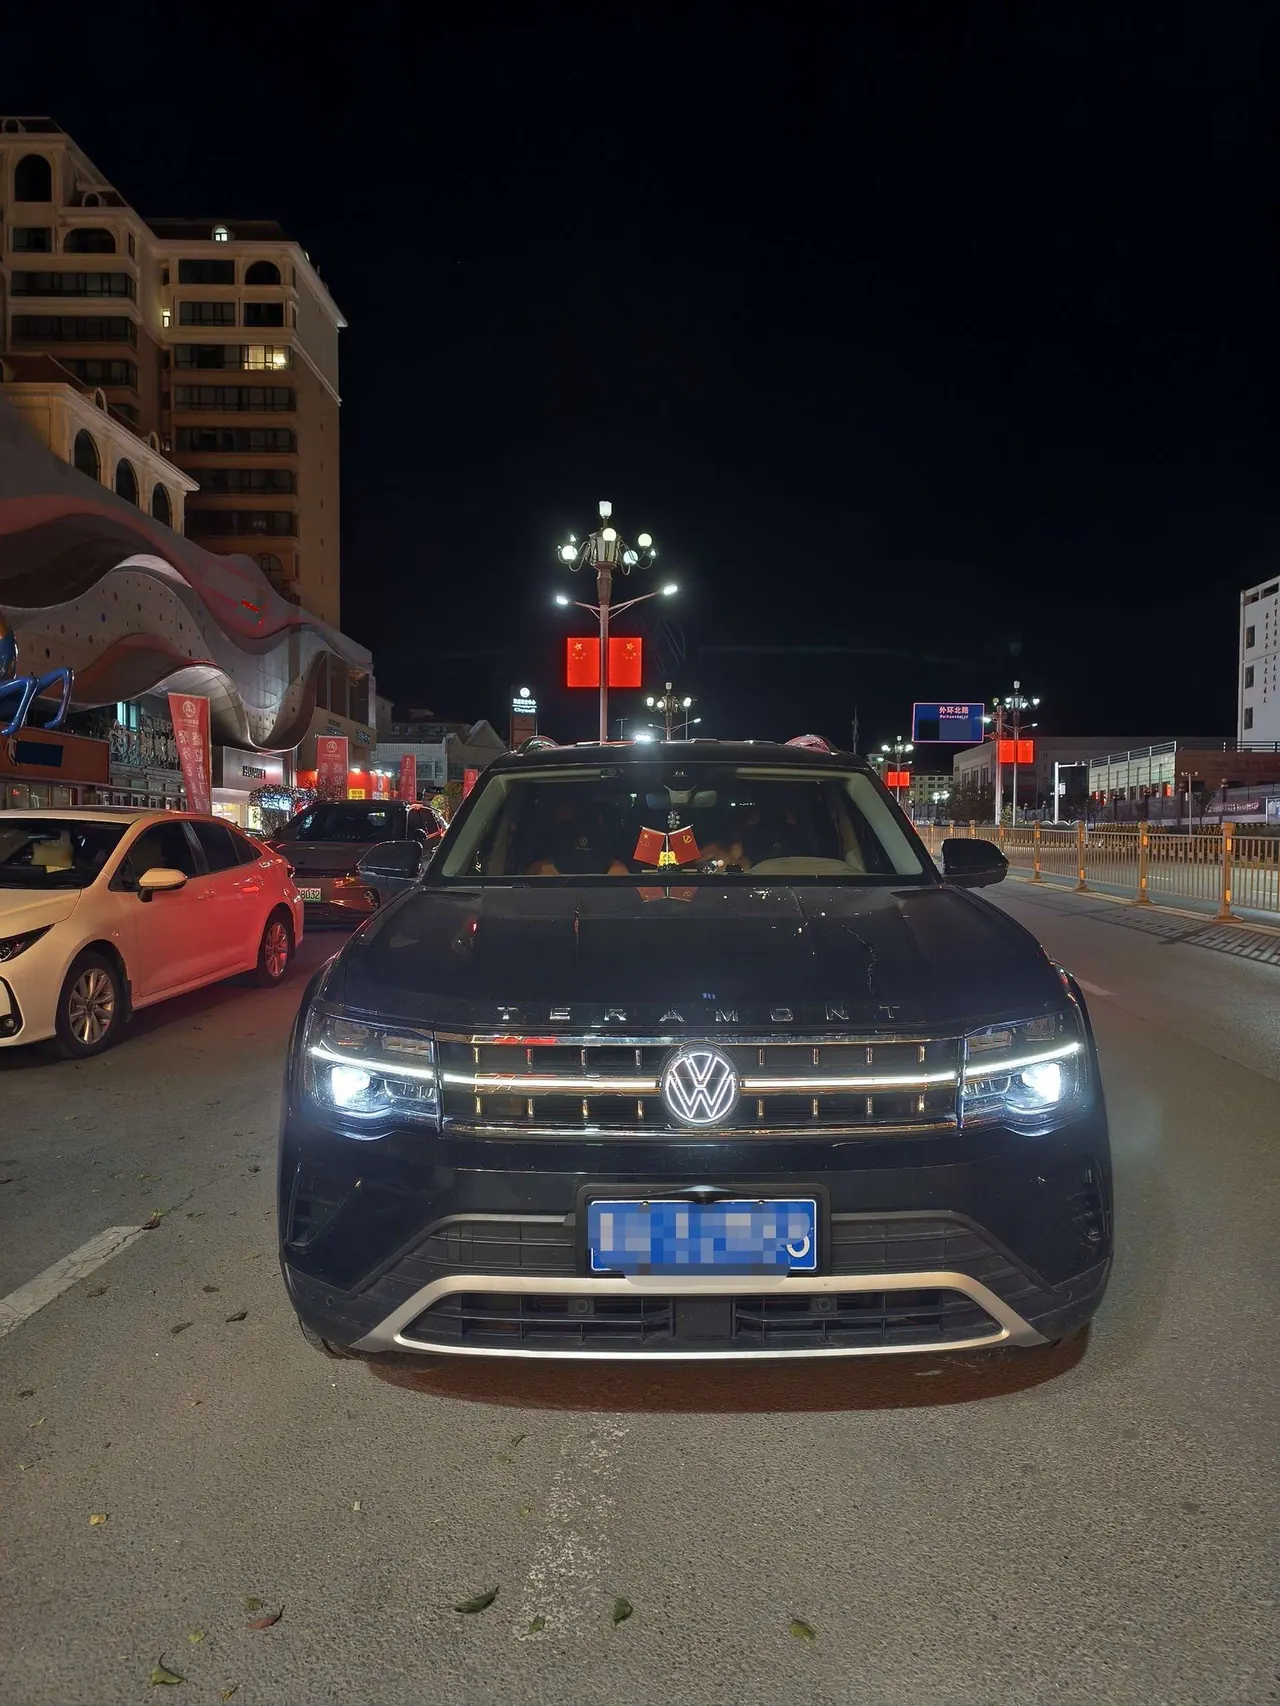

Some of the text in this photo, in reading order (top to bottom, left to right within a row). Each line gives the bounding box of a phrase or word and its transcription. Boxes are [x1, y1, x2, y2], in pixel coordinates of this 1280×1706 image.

[939, 706, 969, 714] 外环北路
[497, 1004, 900, 1022] TERAMONT
